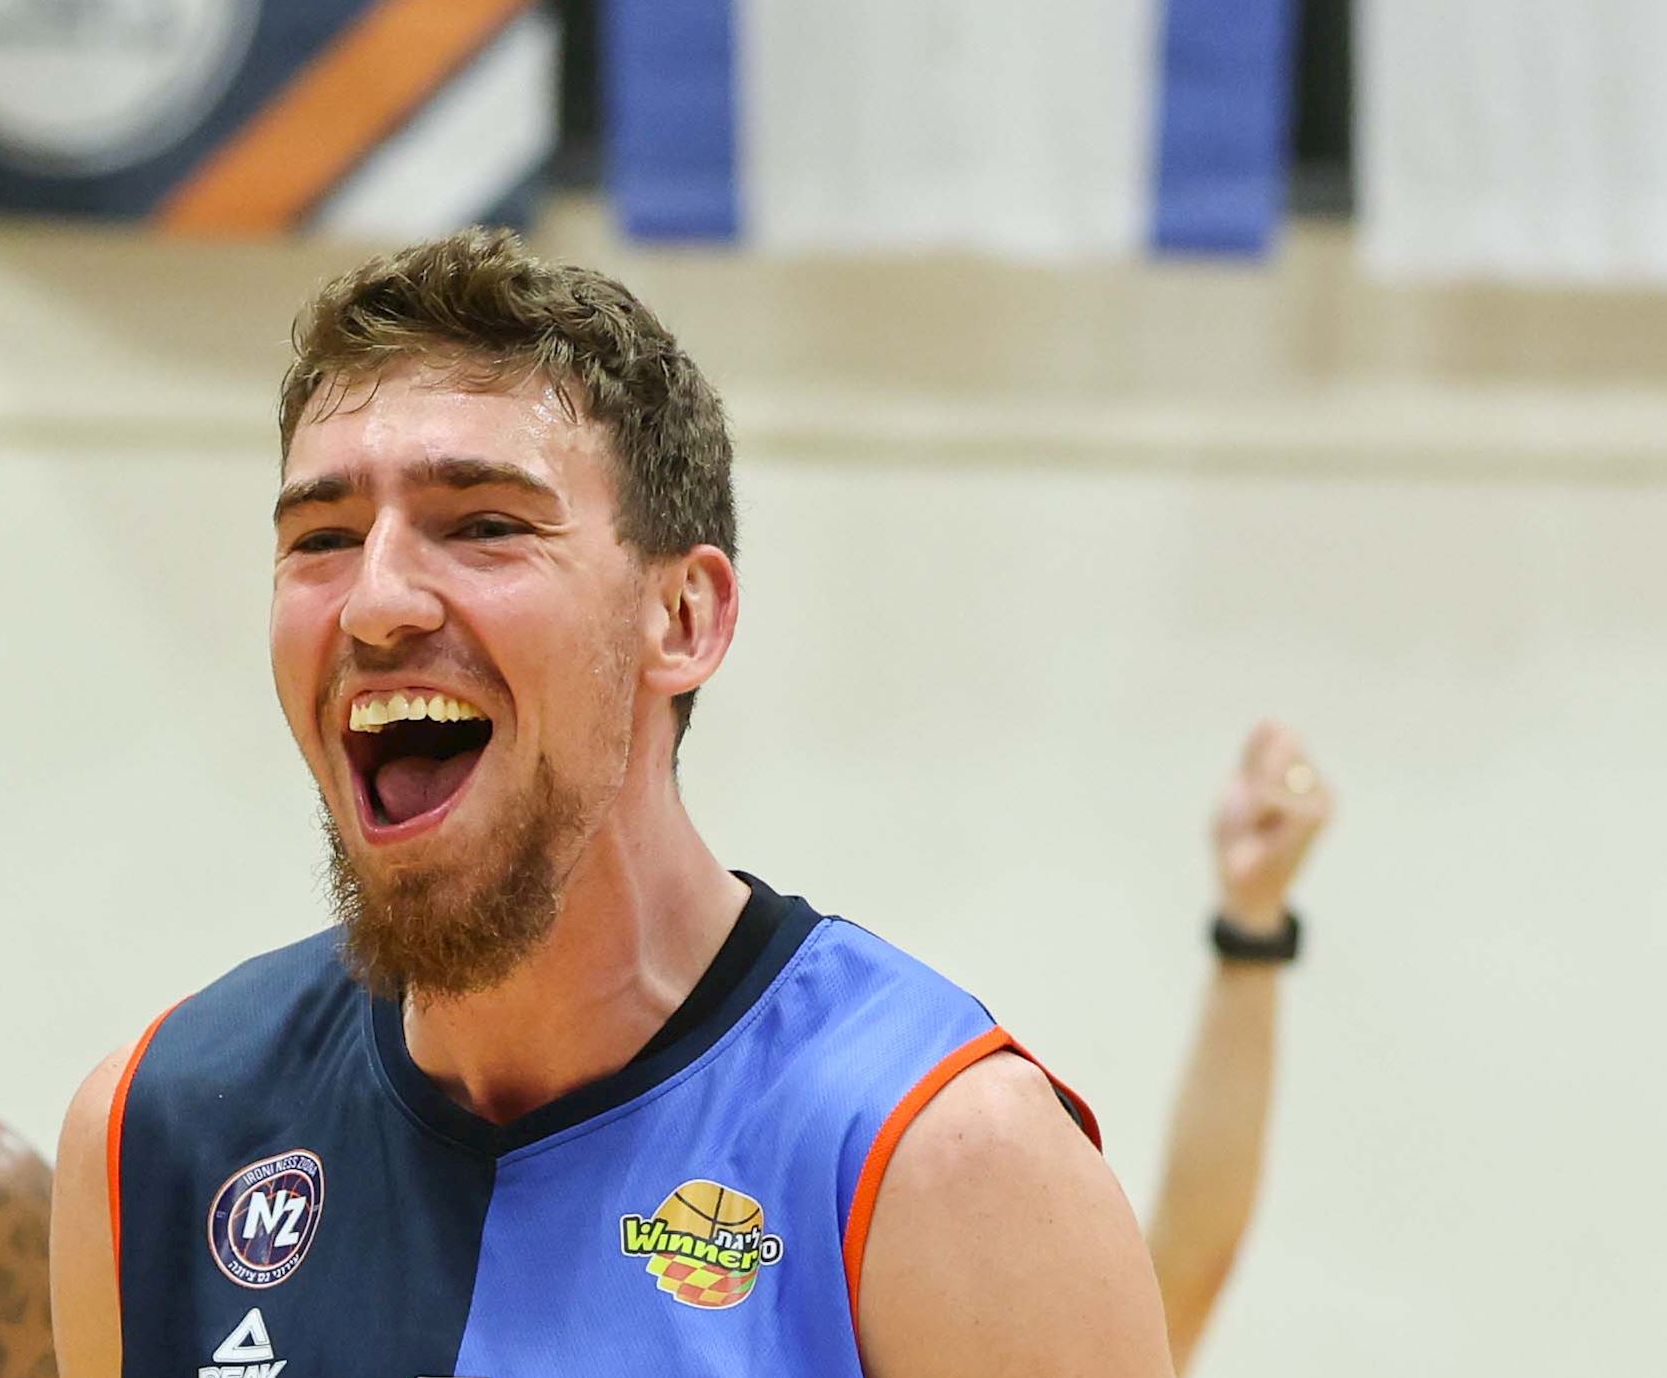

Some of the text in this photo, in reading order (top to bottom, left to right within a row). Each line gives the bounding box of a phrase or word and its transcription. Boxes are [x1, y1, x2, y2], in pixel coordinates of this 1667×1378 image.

[243, 1163, 275, 1185] IRONI
[275, 1156, 299, 1172] NESS
[242, 1189, 306, 1248] NZ
[624, 1217, 760, 1272] Winner
[257, 1271, 270, 1283] נס
